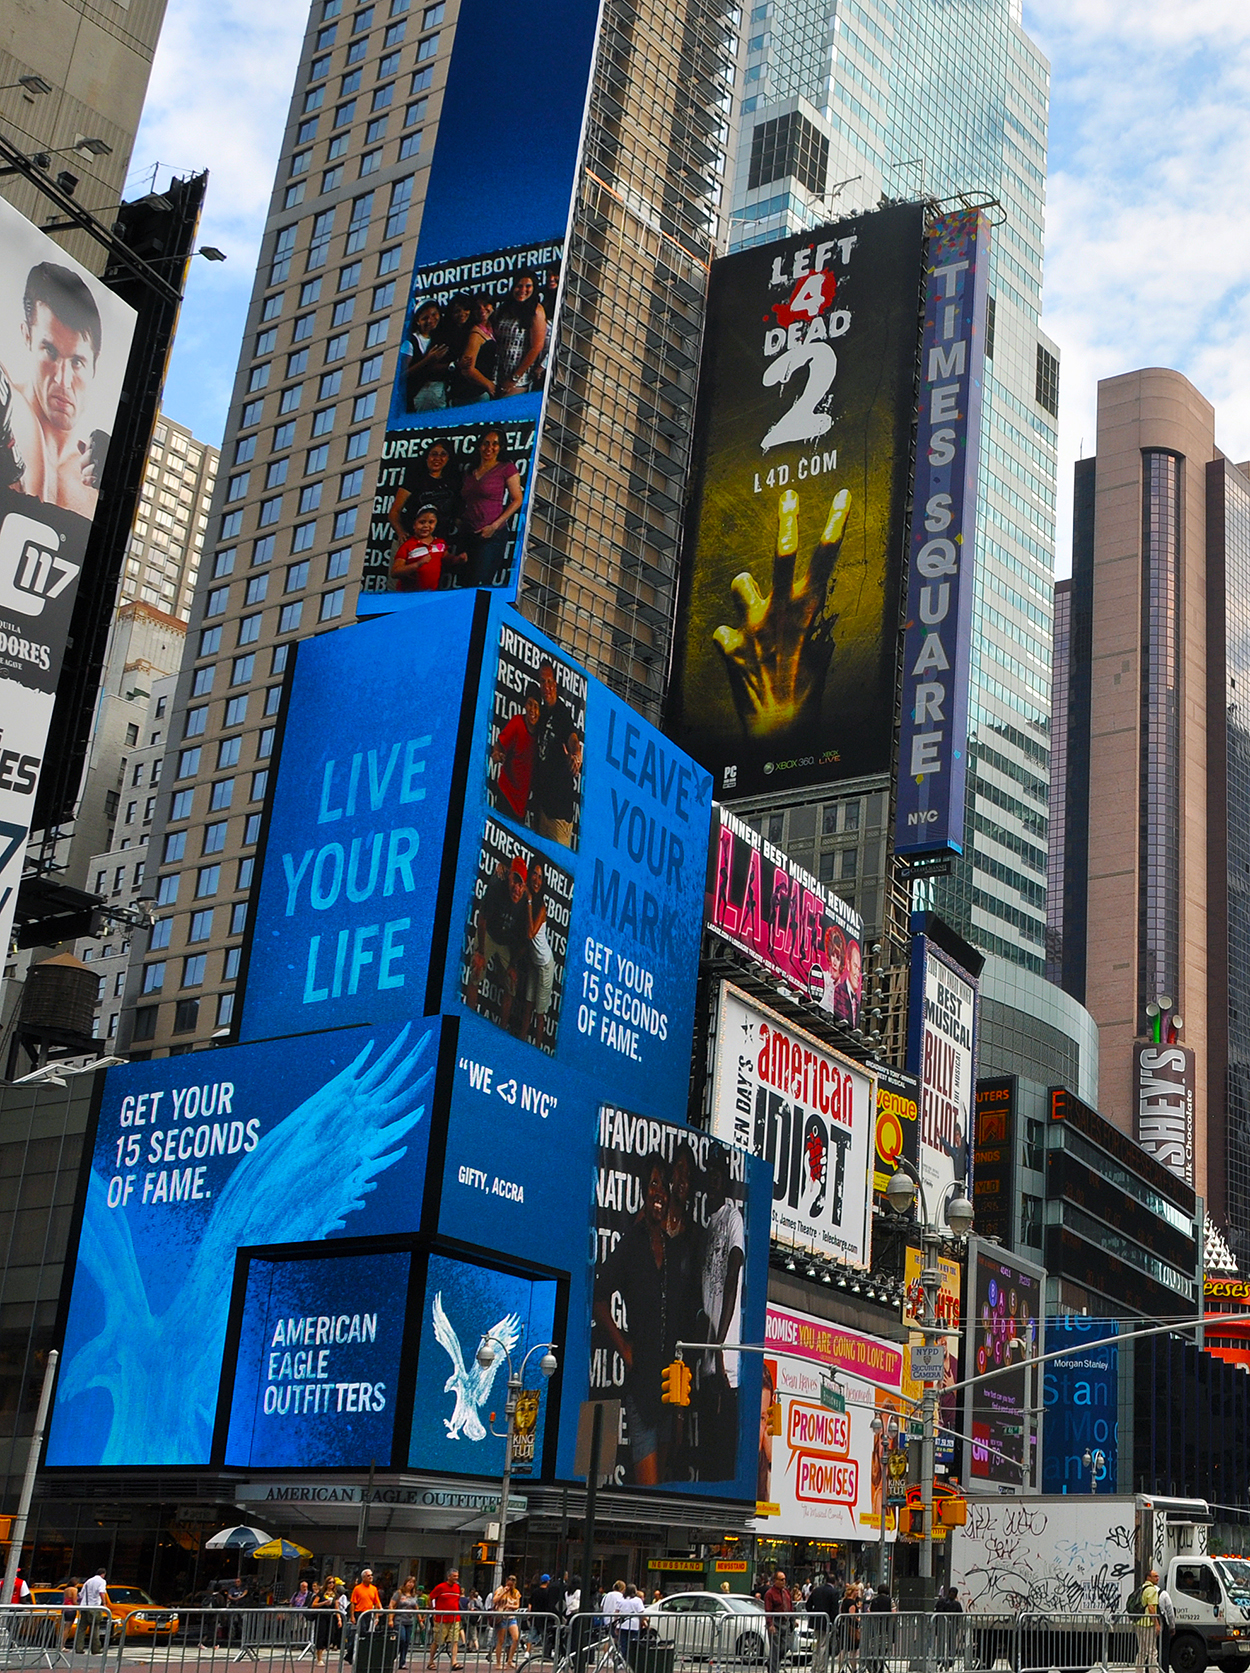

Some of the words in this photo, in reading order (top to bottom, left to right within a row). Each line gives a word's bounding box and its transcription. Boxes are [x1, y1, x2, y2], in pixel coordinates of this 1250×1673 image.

[771, 234, 857, 286] LEFT
[790, 273, 825, 318] 4
[763, 309, 852, 357] DEAD
[926, 259, 970, 467] TIMES
[761, 341, 838, 450] 2
[753, 449, 838, 494] L4D.COM
[910, 492, 958, 777] SQUARE
[316, 734, 432, 825] LIVE
[604, 708, 692, 824] LEAVE
[723, 764, 738, 780] PC
[818, 756, 841, 765] LIVE
[907, 809, 939, 826] NYC
[609, 787, 686, 895] YOUR
[282, 826, 421, 917] YOUR
[719, 806, 762, 852] WINNER!
[763, 842, 789, 873] BEST
[789, 859, 827, 902] MUSICAL
[827, 889, 862, 930] REVIVAL
[588, 857, 680, 956] MARK
[713, 826, 761, 942] LA
[768, 866, 825, 964] CAGE
[302, 916, 411, 1005] LIFE
[584, 936, 614, 974] GET
[615, 948, 655, 999] YOUR
[582, 970, 601, 1001] 15
[603, 979, 669, 1042] SECONDS
[937, 981, 963, 1020] BEST
[578, 1015, 599, 1040] OF
[600, 1014, 643, 1063] FAME.
[925, 997, 971, 1052] MUSICAL
[735, 1054, 755, 1116] DAY'S
[757, 1022, 854, 1127] american
[923, 1028, 956, 1101] BILLY
[953, 1051, 961, 1088] MUSICAL
[120, 1093, 167, 1128] GET
[171, 1081, 235, 1121] YOUR
[496, 1082, 516, 1105] <3
[977, 1089, 1010, 1103] UTERS
[116, 1137, 140, 1168] 15
[147, 1118, 261, 1164] SECONDS
[875, 1110, 904, 1171] Q
[921, 1086, 960, 1158] ELLIOT
[1185, 1089, 1193, 1160] Chocolate
[752, 1084, 852, 1228] IDIOT
[107, 1176, 137, 1209] OF
[142, 1166, 213, 1205] FAME.
[458, 1165, 489, 1195] GIFTY,
[492, 1174, 525, 1203] ACCRA
[780, 1213, 798, 1232] James
[797, 1219, 818, 1239] Theatre
[821, 1229, 858, 1256] Telecharge.com
[271, 1312, 378, 1349] AMERICAN
[765, 1314, 799, 1346] ROMISE
[798, 1324, 816, 1350] YOU
[815, 1331, 832, 1355] ARE
[832, 1335, 856, 1361] GOING
[856, 1342, 866, 1364] TO
[866, 1345, 885, 1370] LOVE
[915, 1347, 940, 1356] NYPD
[268, 1348, 329, 1381] EAGLE
[780, 1367, 798, 1388] Sean
[799, 1373, 818, 1394] Hayes
[911, 1363, 943, 1373] SECURITY
[912, 1370, 942, 1379] CAMERA
[1053, 1359, 1084, 1370] Morgan
[1083, 1359, 1109, 1371] Stanley
[263, 1380, 387, 1417] OUTFITTERS
[512, 1433, 534, 1446] KING
[512, 1445, 533, 1457] TUT
[265, 1486, 355, 1502] AMERICAN
[360, 1489, 418, 1505] EAGLE
[801, 1462, 855, 1498] PROMISES
[888, 1479, 906, 1487] KING
[888, 1486, 906, 1496] TUT
[651, 1561, 701, 1571] NEWSSTAND
[717, 1561, 746, 1572] NEWSSTAND
